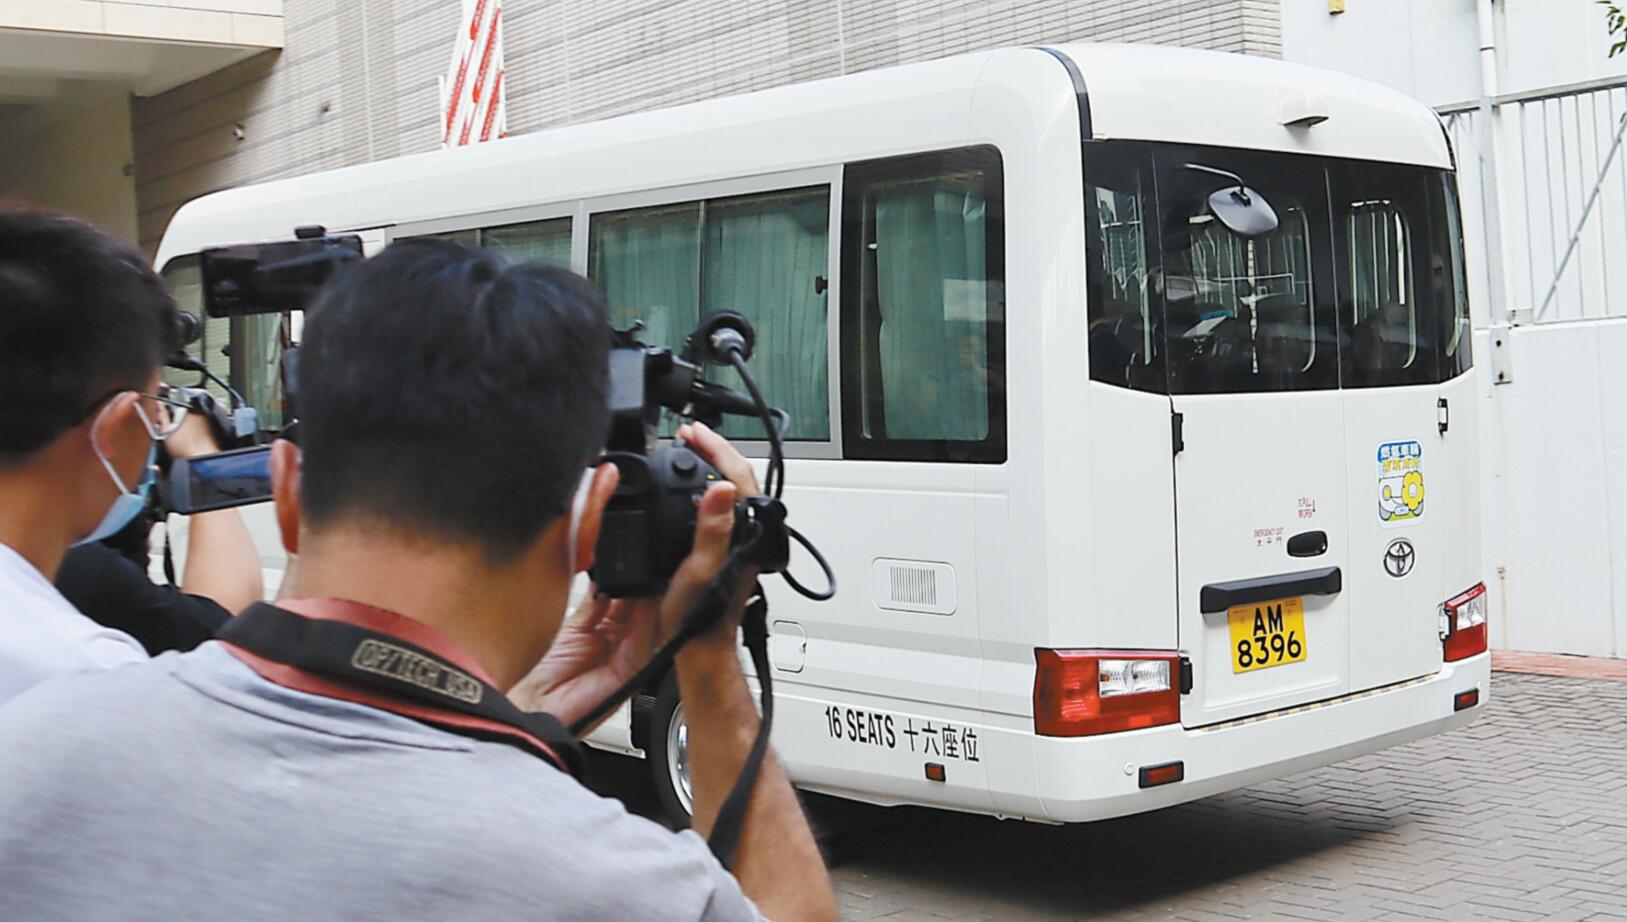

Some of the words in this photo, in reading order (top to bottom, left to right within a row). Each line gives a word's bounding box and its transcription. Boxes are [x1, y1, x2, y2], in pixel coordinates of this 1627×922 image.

[1253, 604, 1283, 636] AM
[1237, 631, 1302, 668] 8396
[445, 671, 479, 698] USA
[825, 706, 843, 739] 16
[846, 709, 896, 748] SEATS
[903, 718, 979, 762] 十六座位
